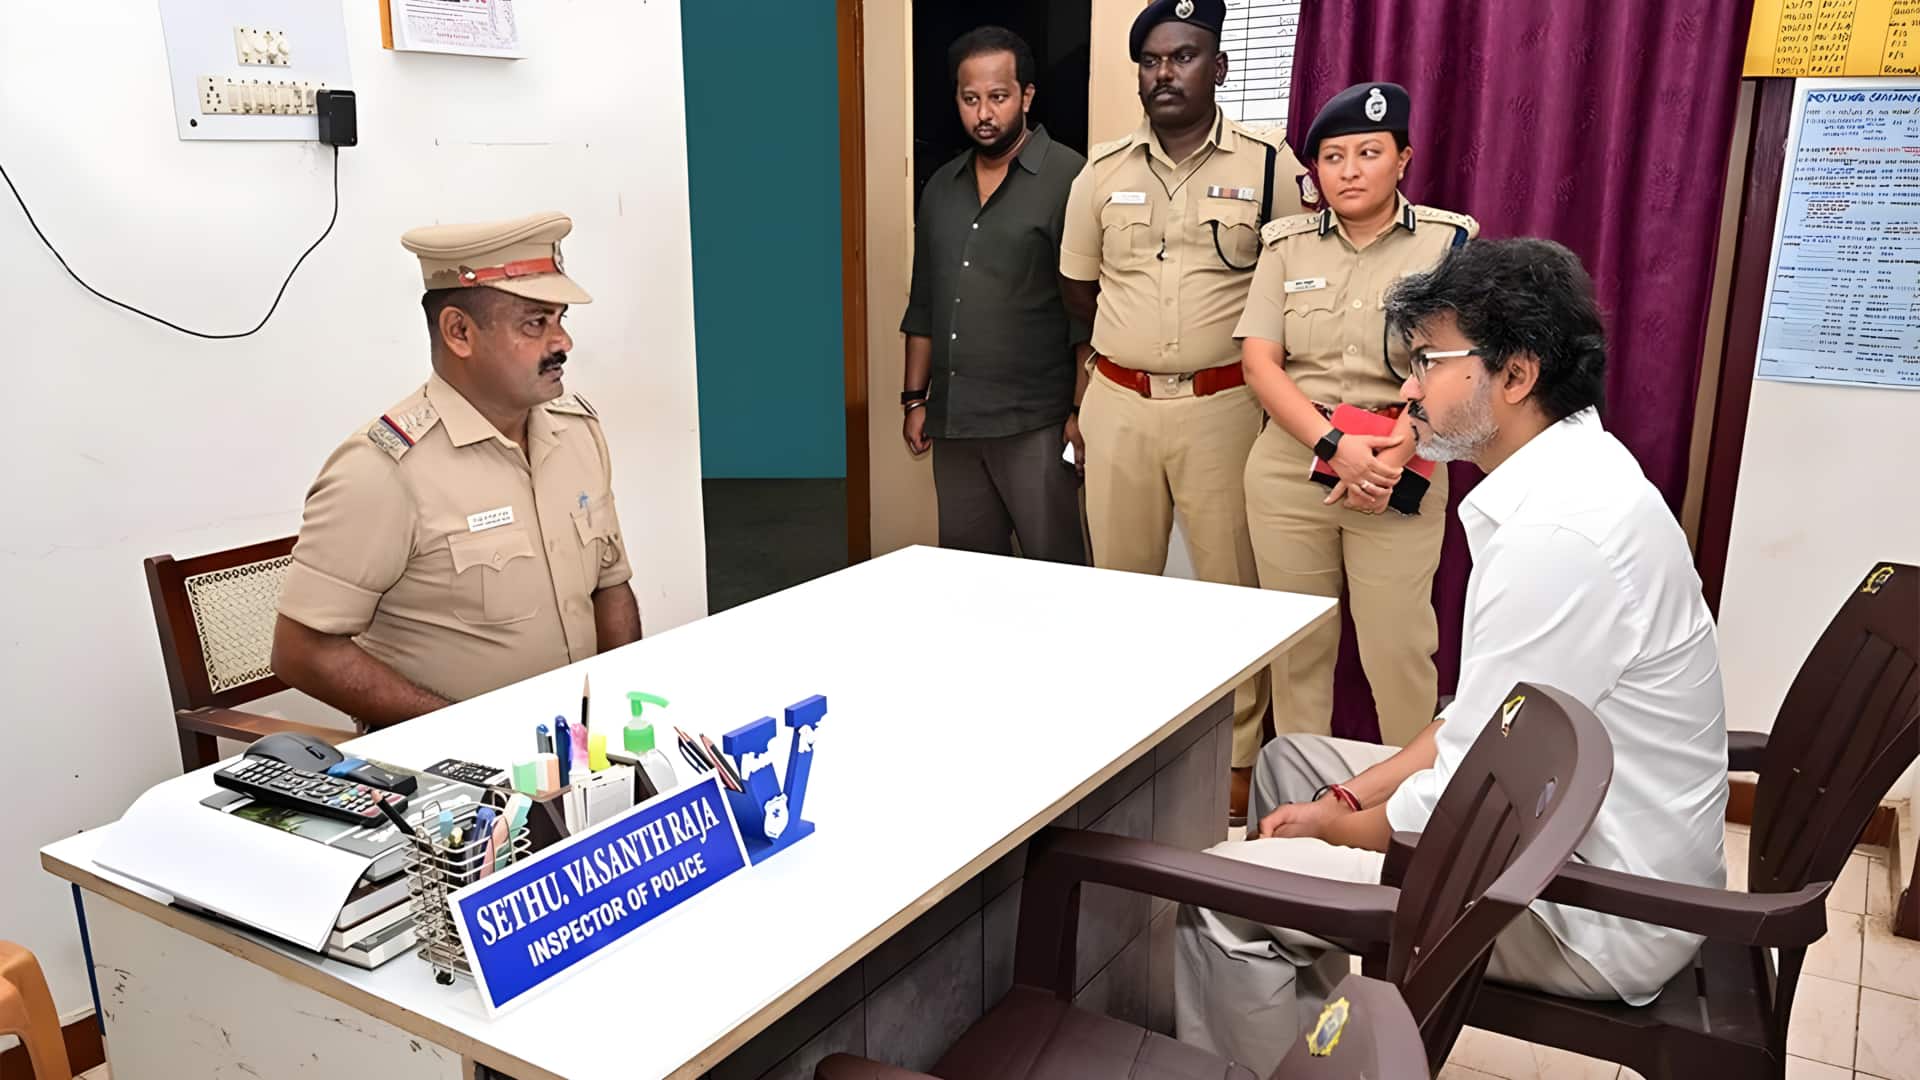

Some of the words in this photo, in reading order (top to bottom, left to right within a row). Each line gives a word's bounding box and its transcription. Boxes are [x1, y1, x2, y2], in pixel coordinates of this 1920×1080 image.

[476, 871, 570, 946] SETHU.
[561, 818, 673, 897] VASANTH
[664, 796, 720, 847] RAJA
[527, 896, 628, 967] INSPECTOR
[626, 882, 648, 911] OF
[649, 852, 707, 898] POLICE
